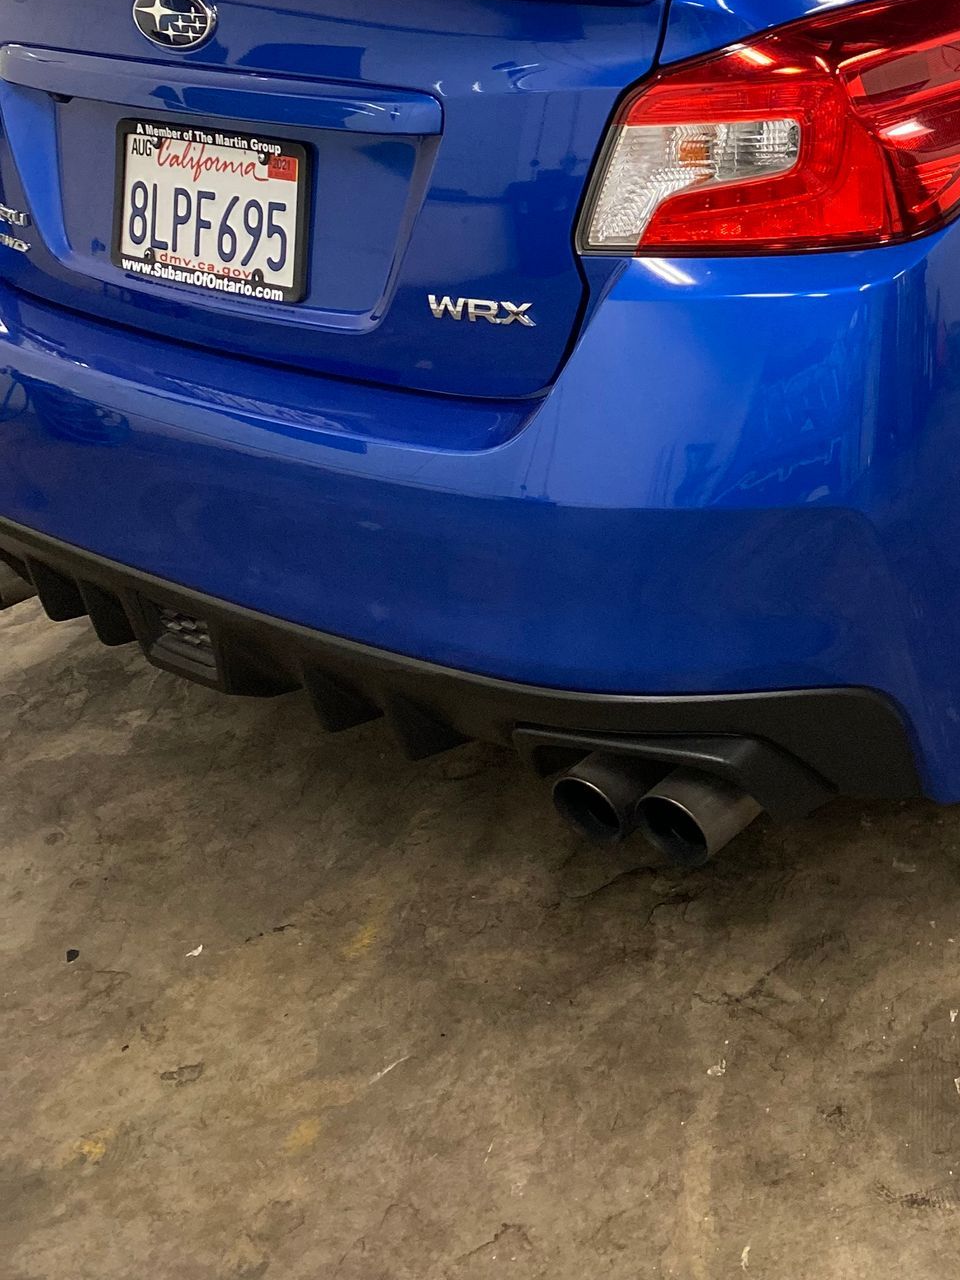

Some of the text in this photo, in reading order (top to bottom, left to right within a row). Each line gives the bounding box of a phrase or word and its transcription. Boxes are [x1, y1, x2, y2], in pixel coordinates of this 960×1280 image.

[131, 138, 152, 156] AUG
[136, 124, 281, 156] A Member of The Martin Group
[157, 138, 269, 182] California
[272, 158, 291, 171] 2021
[129, 181, 287, 272] 8LPF695
[121, 257, 284, 302] www.SubaruOfOntario.com
[159, 252, 251, 279] dmv.ca.gov
[428, 294, 537, 326] WRX
